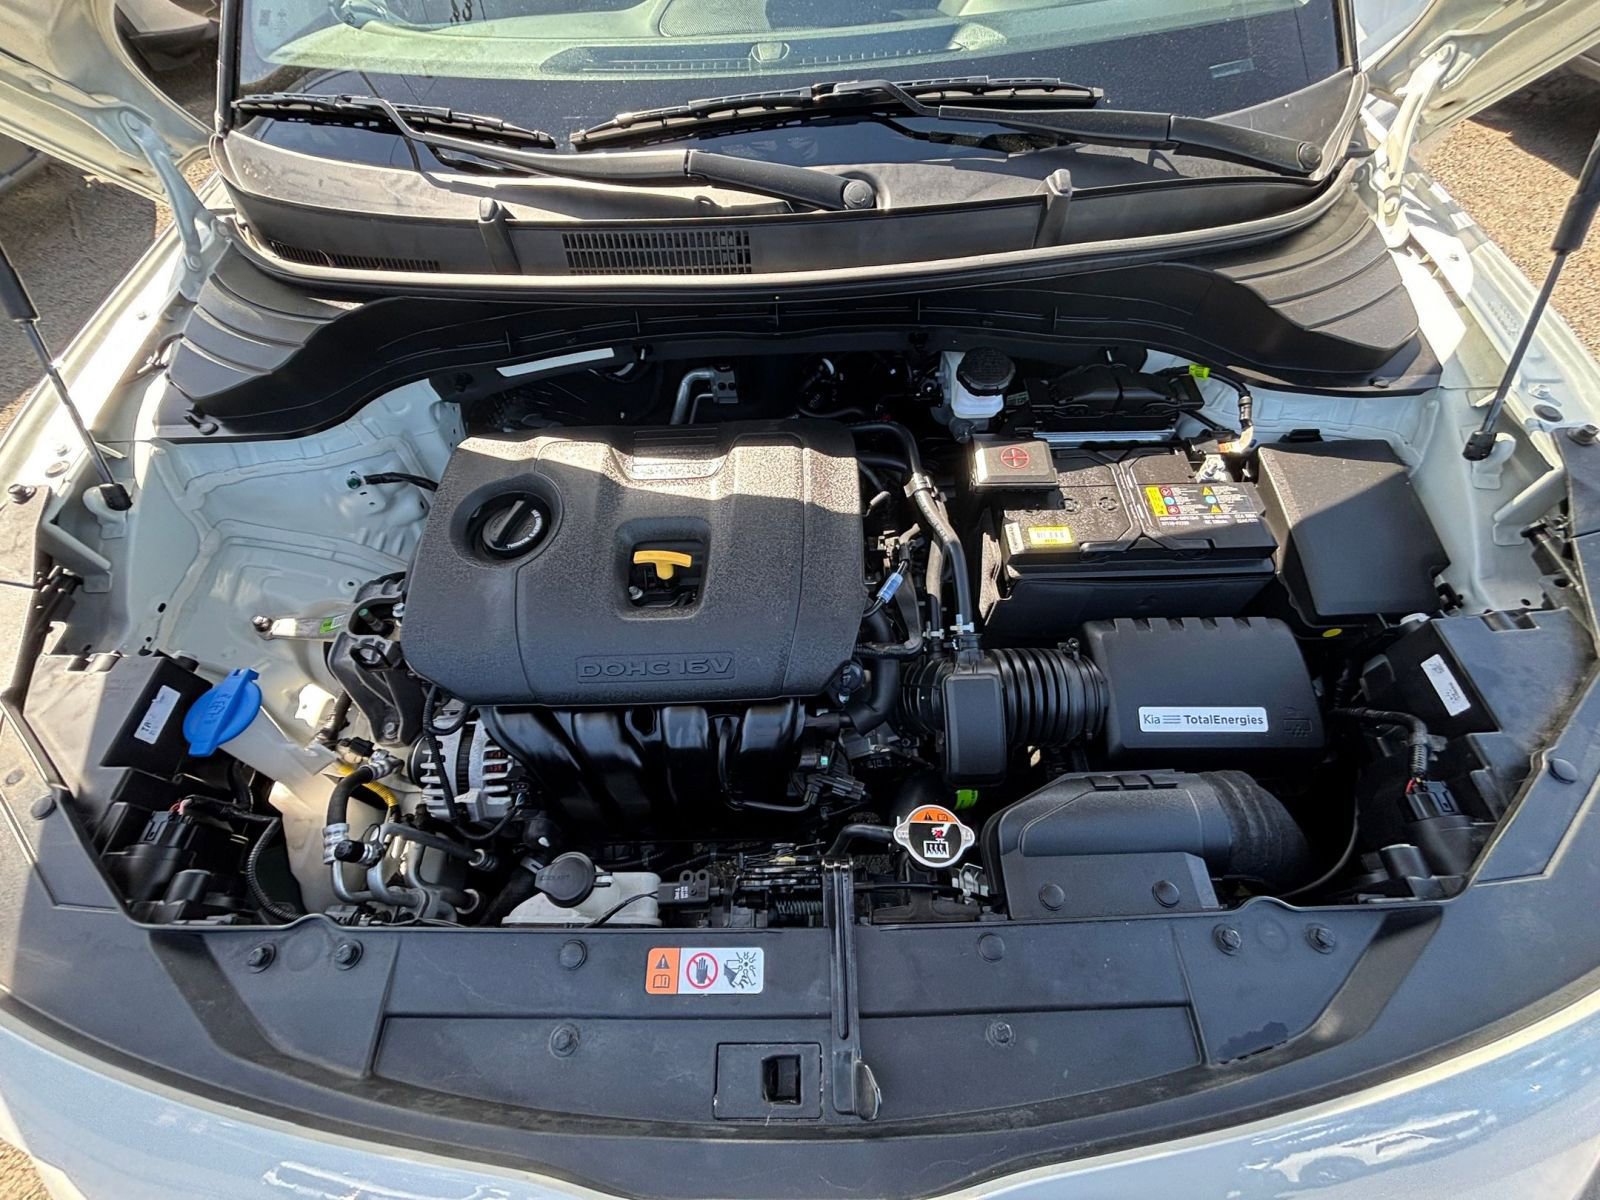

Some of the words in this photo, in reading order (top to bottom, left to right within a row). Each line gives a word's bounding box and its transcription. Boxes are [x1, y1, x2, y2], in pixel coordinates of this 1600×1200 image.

[579, 660, 670, 678] DOHC
[679, 657, 733, 675] 16V
[1143, 713, 1161, 725] Kia
[1183, 713, 1264, 727] TotalEnergies
